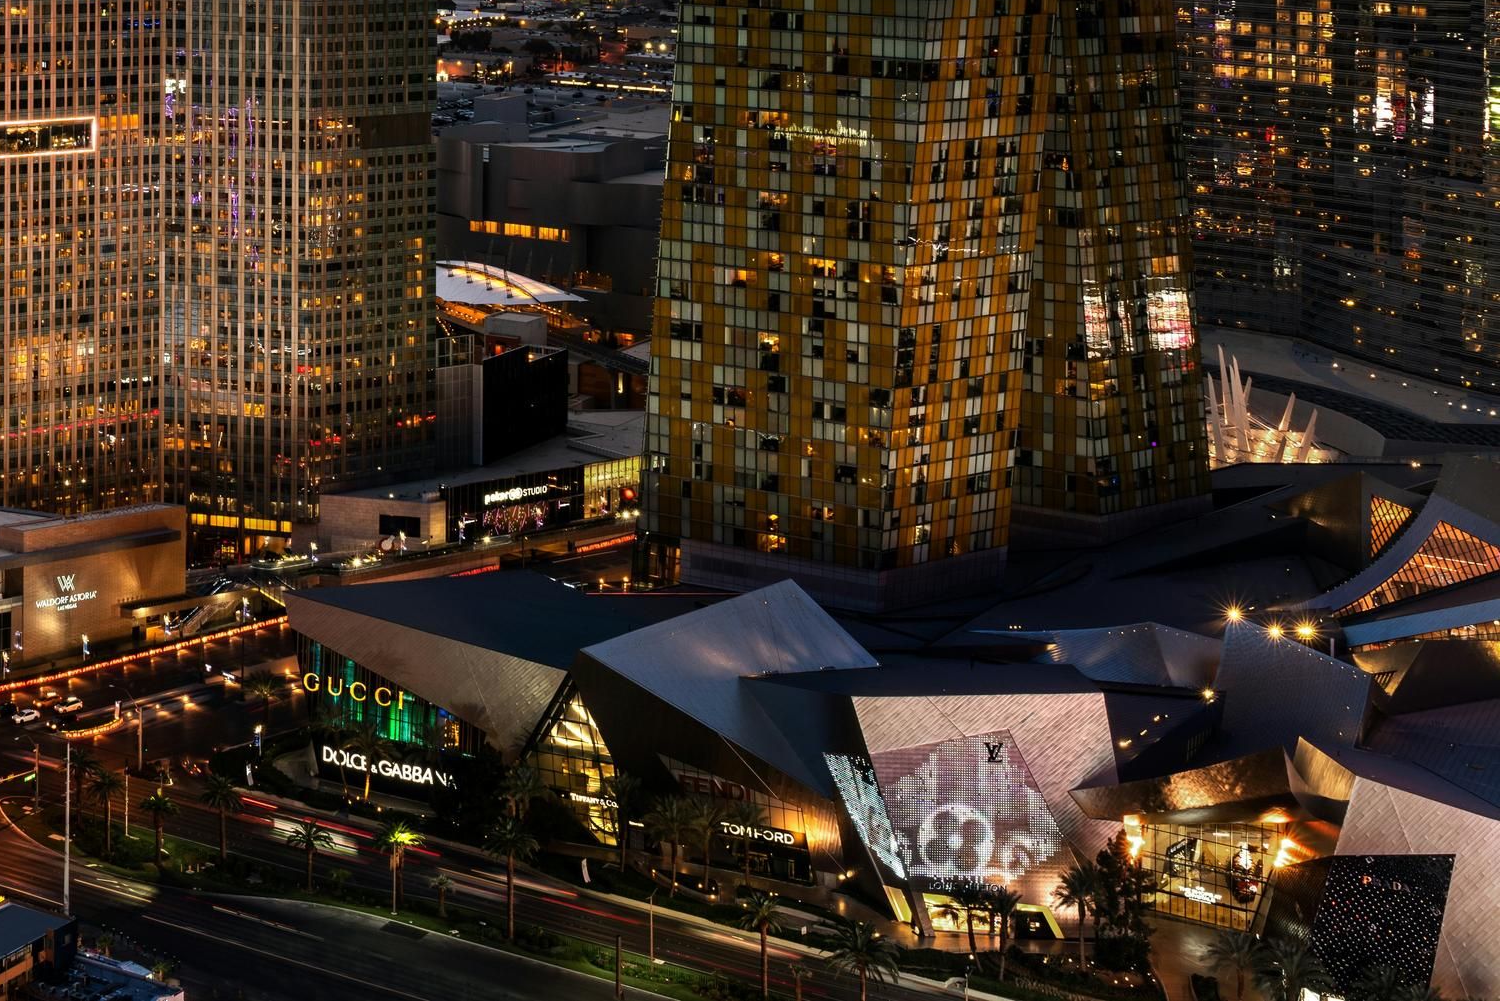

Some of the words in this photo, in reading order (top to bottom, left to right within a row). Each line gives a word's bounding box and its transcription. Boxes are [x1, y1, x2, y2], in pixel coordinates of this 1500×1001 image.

[522, 485, 548, 497] STUDIO
[35, 595, 69, 609] WALDORF
[69, 591, 97, 603] ASTORIA
[303, 672, 404, 710] GUCCI
[322, 745, 367, 771] DOLCE
[370, 764, 378, 774] &
[984, 742, 1004, 763] LV
[570, 792, 599, 805] TIFFANY
[720, 821, 752, 838] TOM
[754, 828, 795, 845] FORD
